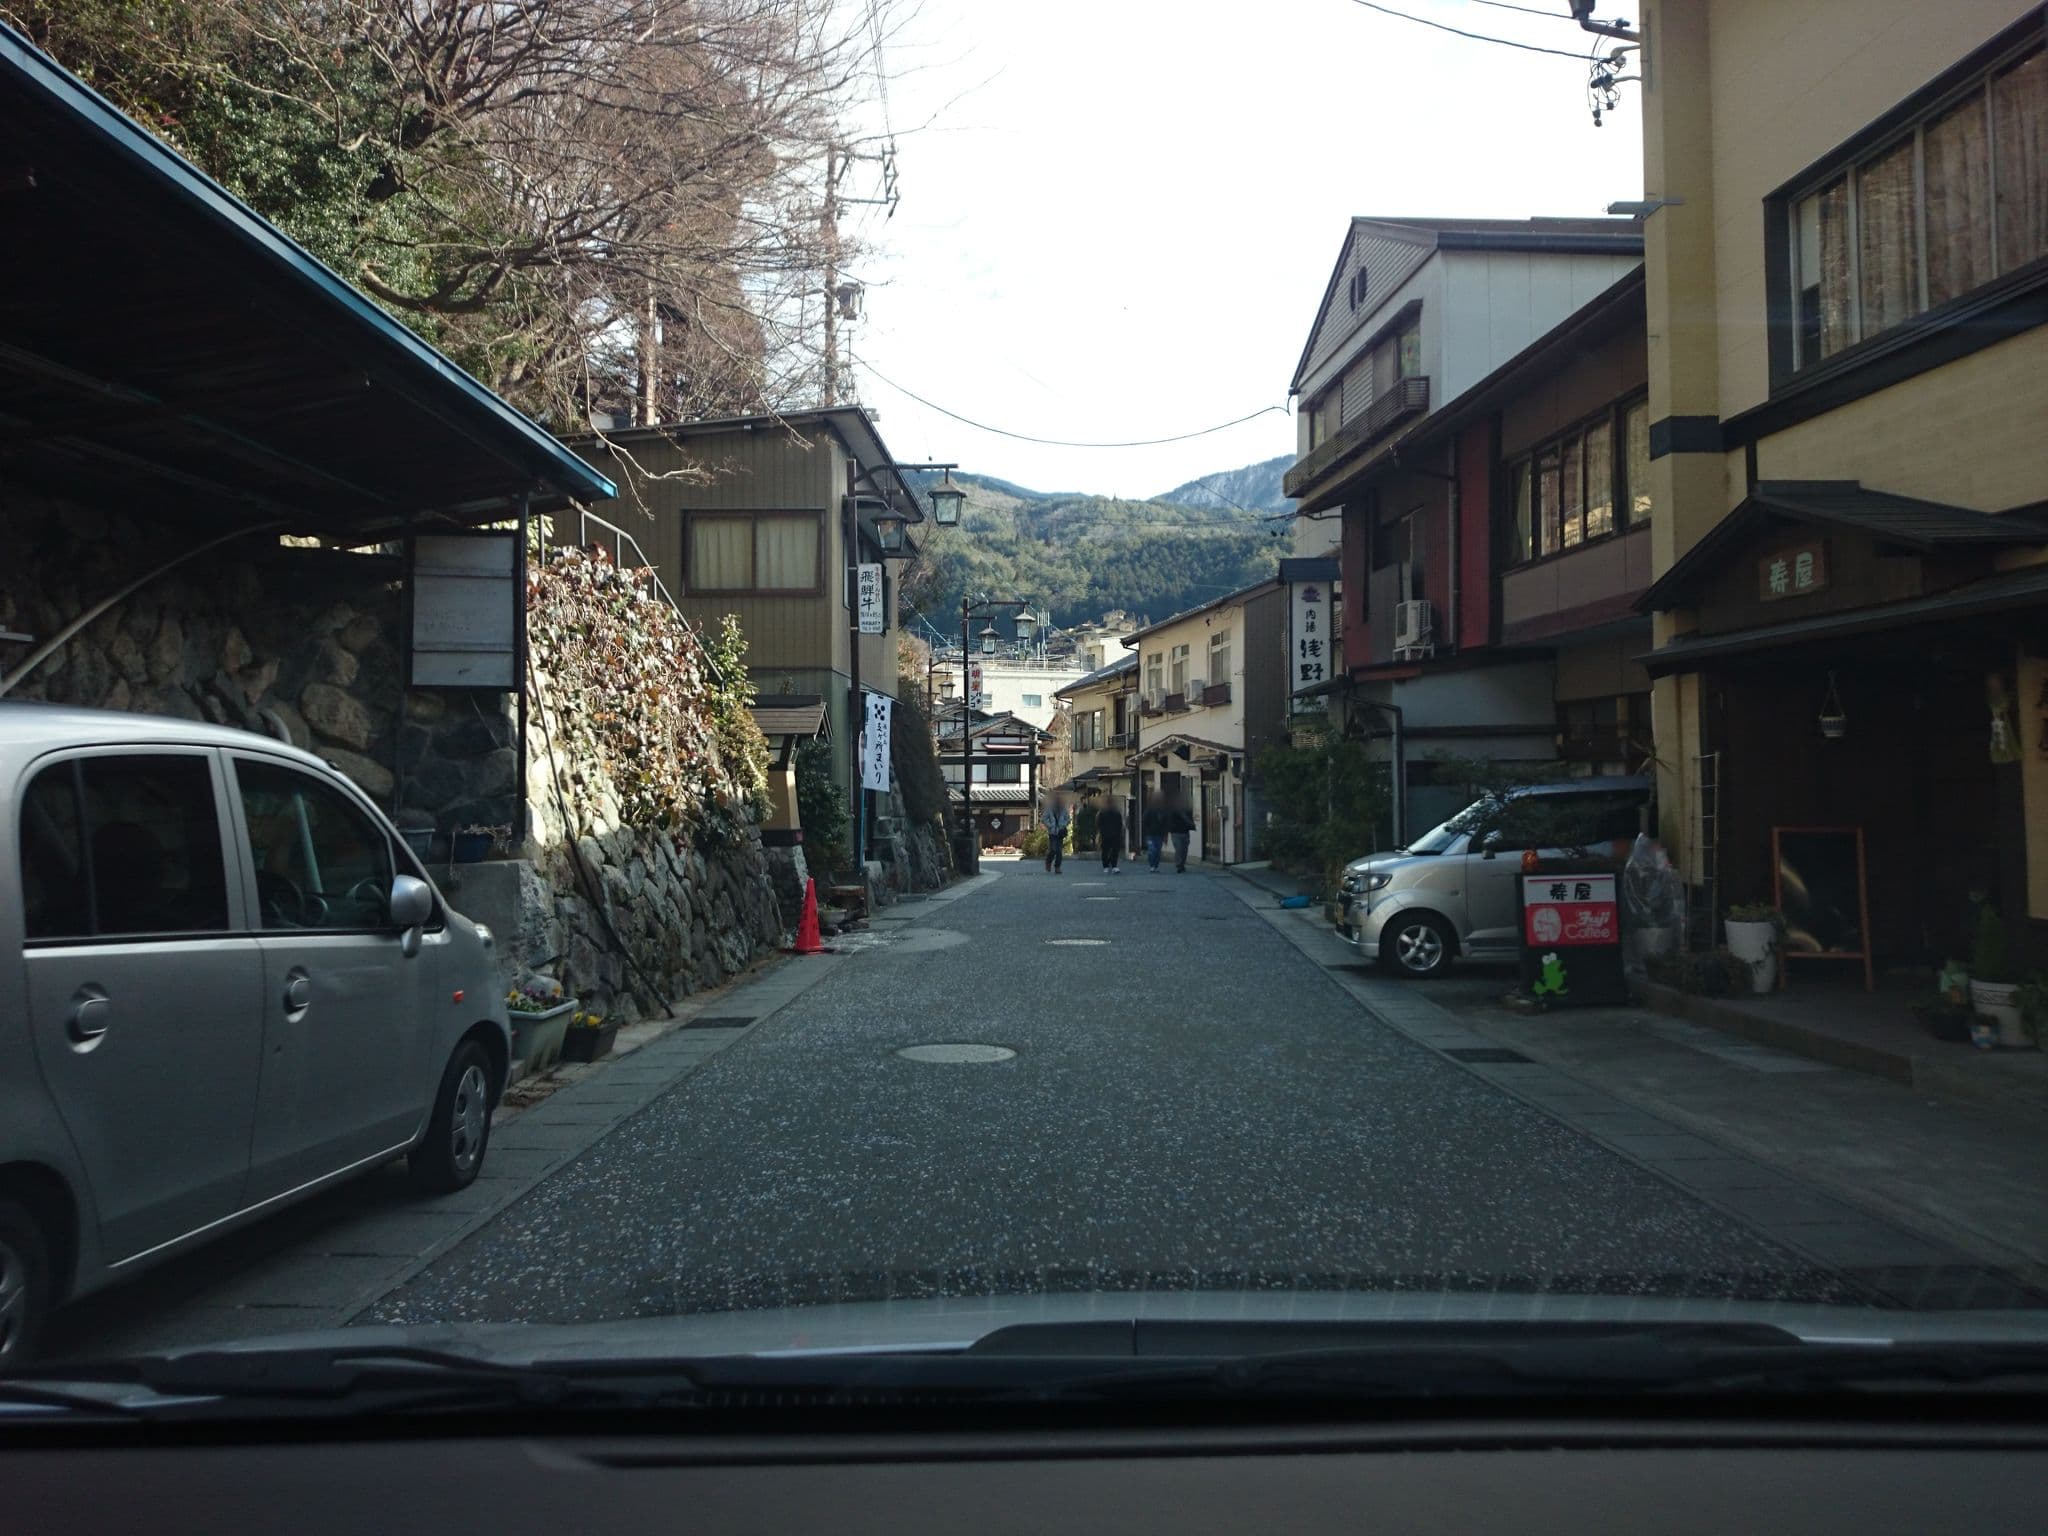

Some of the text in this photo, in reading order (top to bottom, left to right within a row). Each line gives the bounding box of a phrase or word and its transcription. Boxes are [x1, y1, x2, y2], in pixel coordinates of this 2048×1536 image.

[860, 571, 875, 611] 飛騨牛
[1577, 911, 1611, 928] Fuji
[1565, 923, 1610, 938] Coffee
